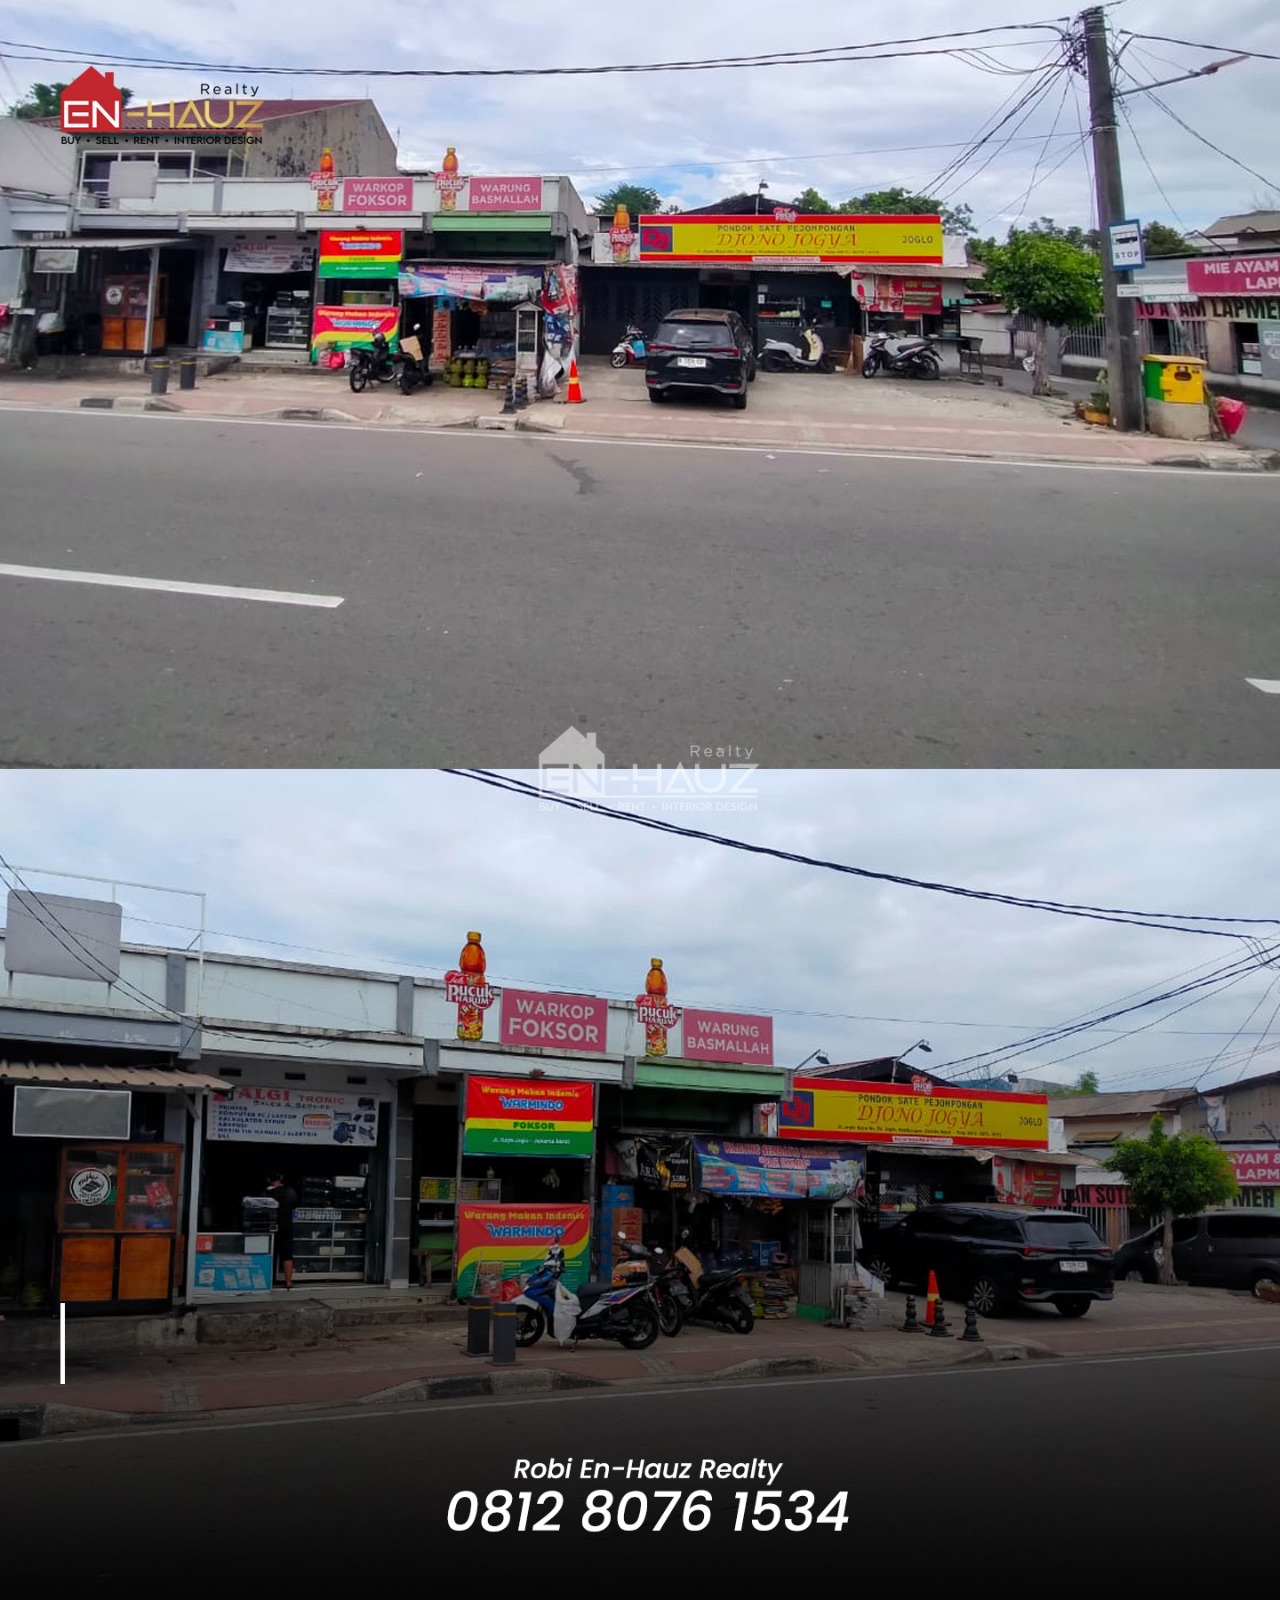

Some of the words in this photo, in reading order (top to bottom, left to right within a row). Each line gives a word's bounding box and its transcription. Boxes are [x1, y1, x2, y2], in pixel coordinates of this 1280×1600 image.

[352, 183, 404, 193] WARKOP
[480, 184, 531, 193] WARUNG
[347, 194, 407, 206] FOKSOR
[471, 195, 539, 204] BASMALLAH
[901, 236, 934, 244] JOGLO
[1115, 251, 1139, 259] STOP
[1204, 262, 1230, 274] MIE
[1233, 261, 1279, 273] AYAM
[516, 998, 595, 1020] WARKOP
[508, 1016, 598, 1043] FOKSOR
[697, 1020, 760, 1037] WARUNG
[687, 1036, 769, 1054] BASMALLAH
[481, 1085, 515, 1096] Warung
[300, 1094, 345, 1105] TRONIC
[498, 1096, 564, 1111] WARMINDO
[858, 1093, 892, 1104] PONDOK
[898, 1095, 919, 1106] SATE
[924, 1098, 983, 1110] PEJOMPONGAN
[218, 1110, 256, 1118] KOMPUTER
[857, 1104, 923, 1124] DJONO
[925, 1108, 984, 1129] JOGYA
[513, 1121, 555, 1130] FOKSOR
[1019, 1116, 1042, 1127] JOGLO
[464, 1211, 506, 1221] Warung
[508, 1211, 543, 1220] Makan
[486, 1223, 565, 1238] WARMINDO
